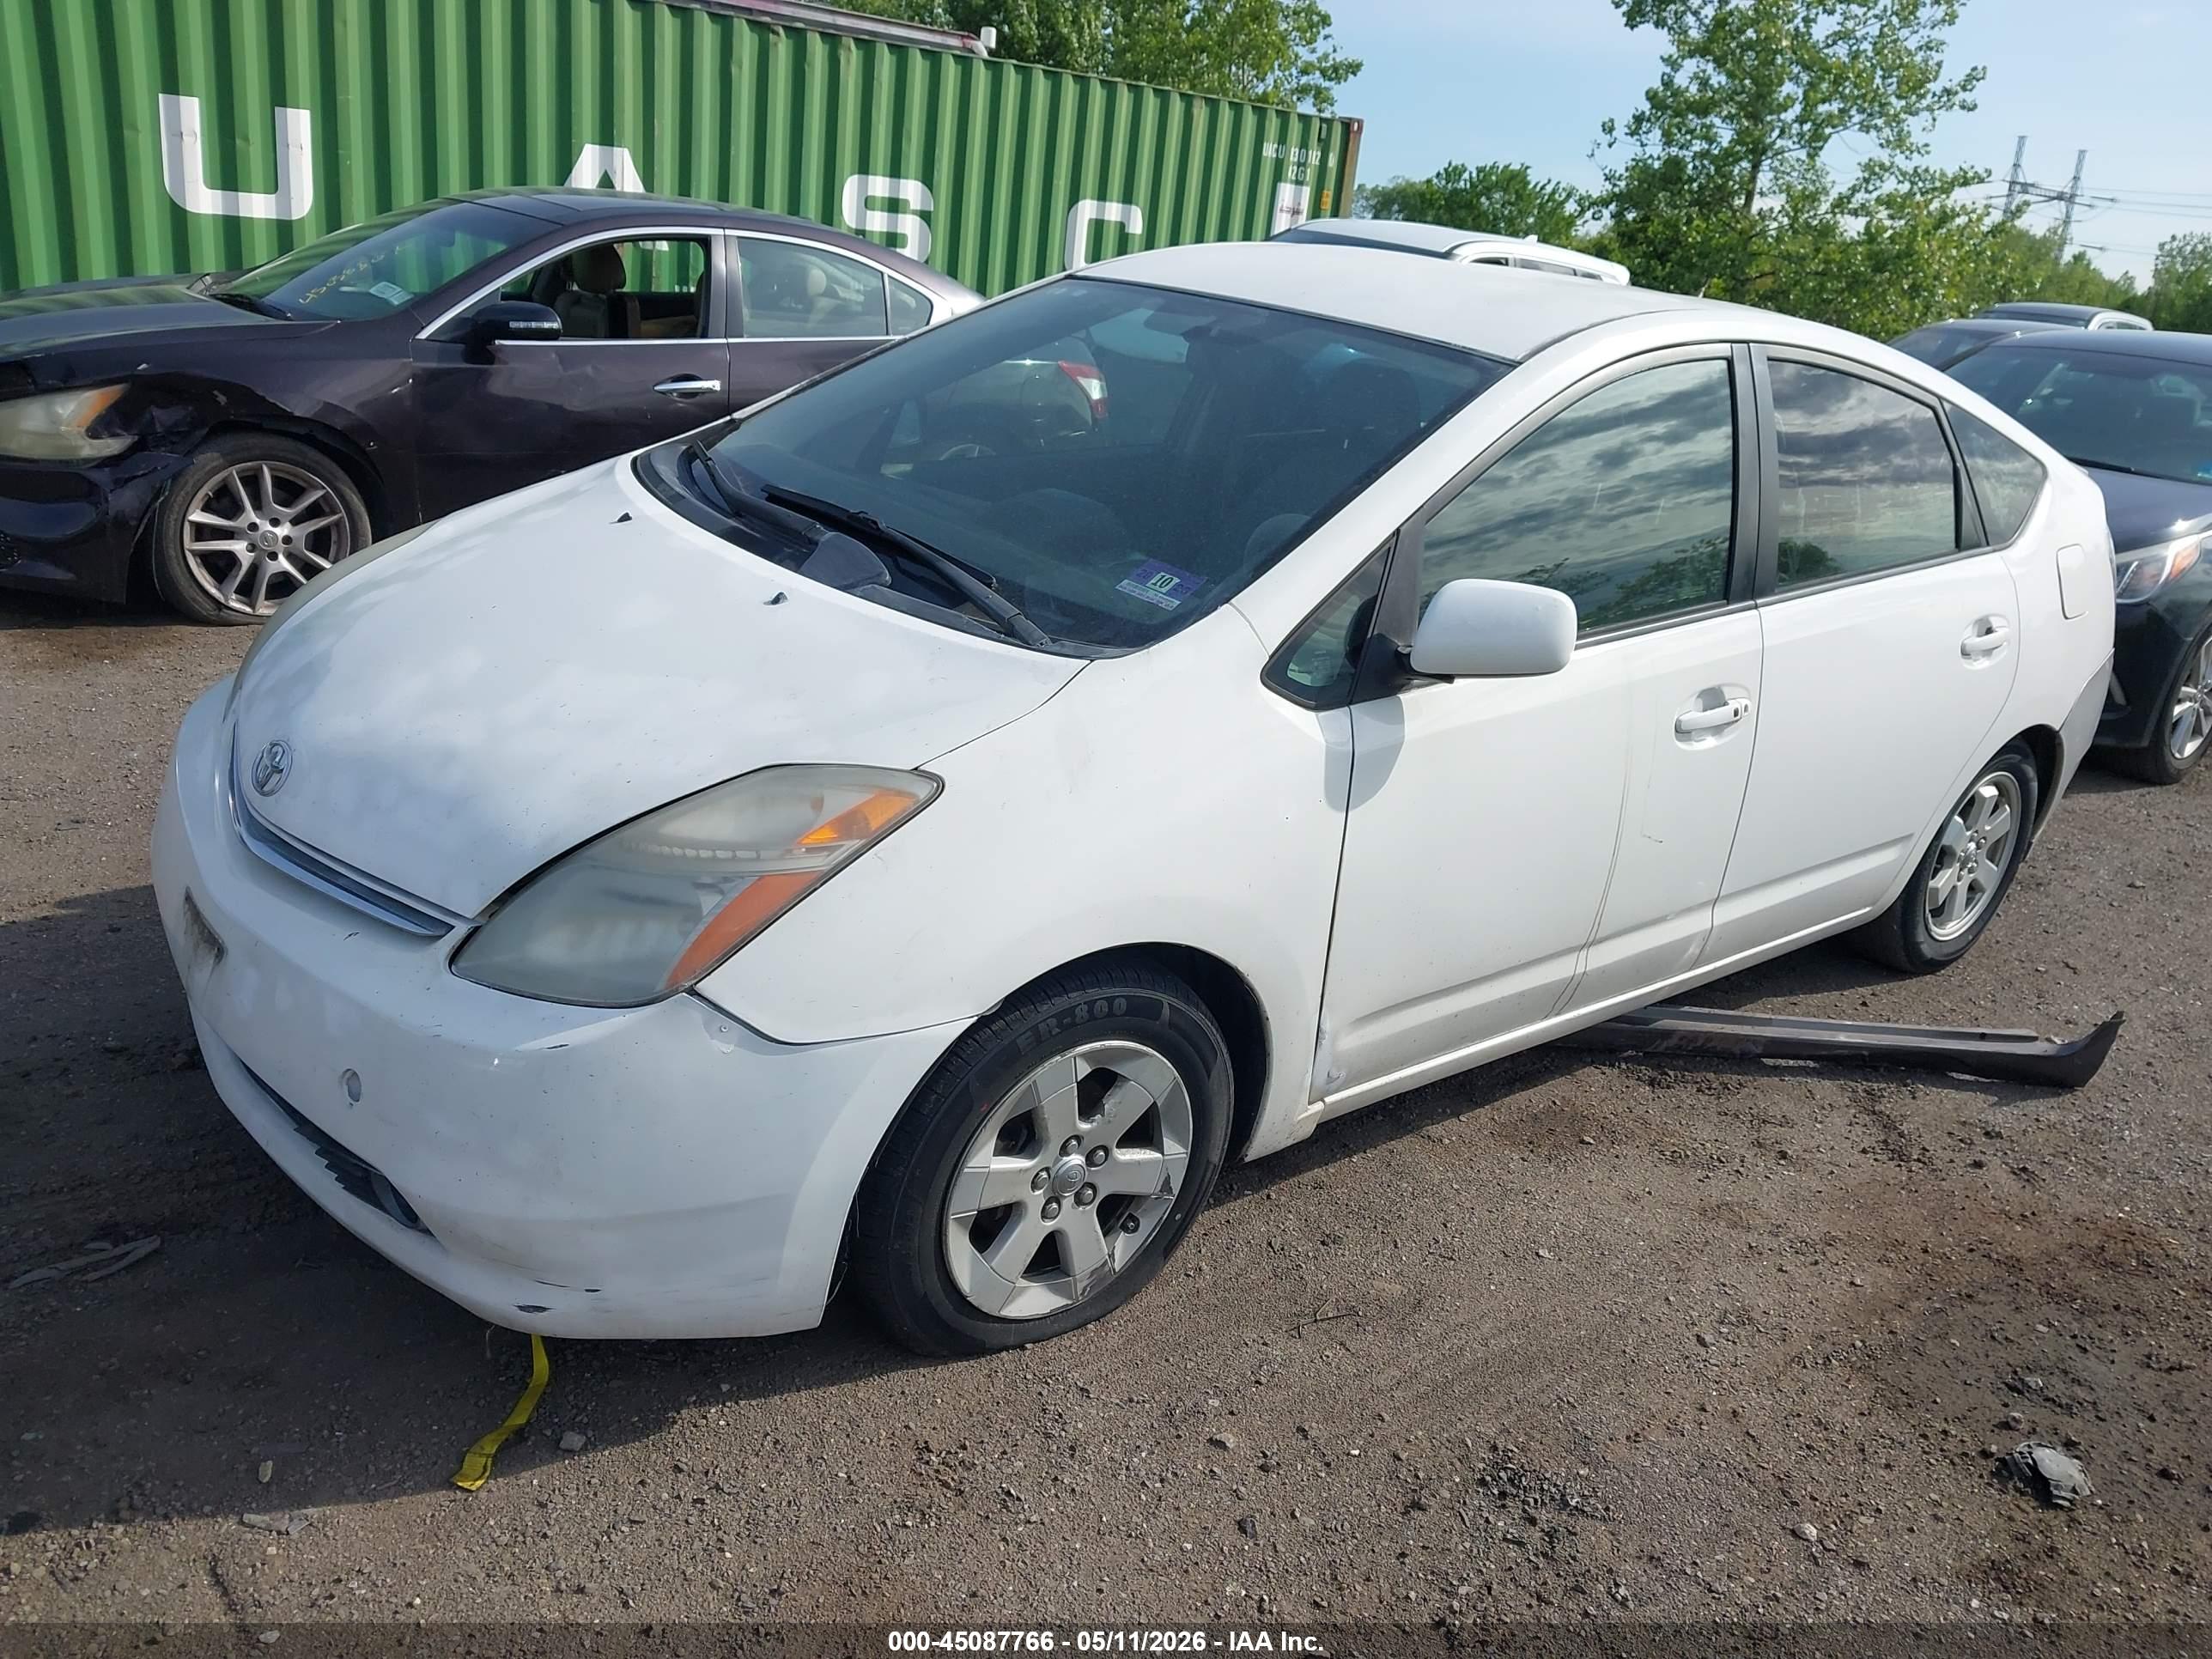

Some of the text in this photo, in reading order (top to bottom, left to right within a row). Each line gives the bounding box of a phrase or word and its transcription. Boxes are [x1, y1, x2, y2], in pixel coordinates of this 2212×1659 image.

[158, 93, 313, 220] U
[842, 173, 933, 264] S
[1151, 574, 1174, 588] 10
